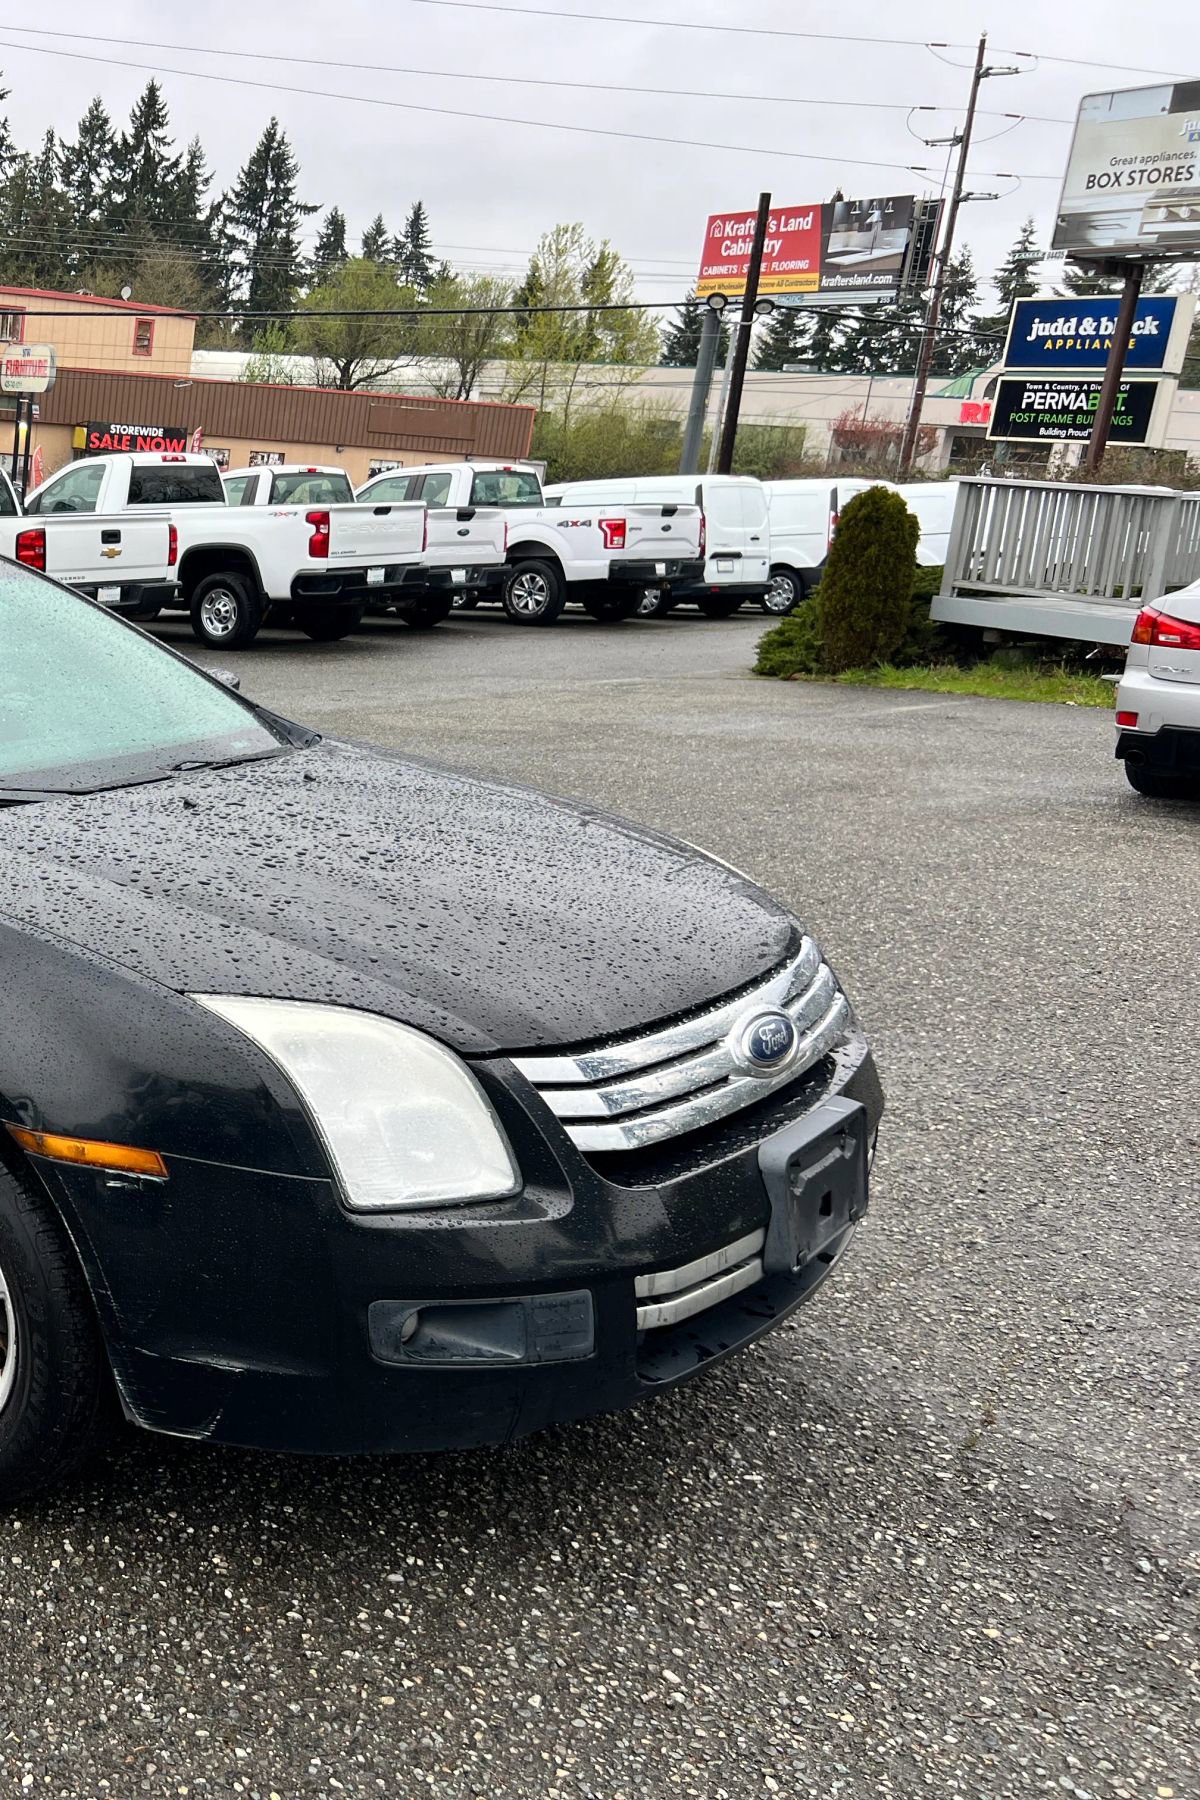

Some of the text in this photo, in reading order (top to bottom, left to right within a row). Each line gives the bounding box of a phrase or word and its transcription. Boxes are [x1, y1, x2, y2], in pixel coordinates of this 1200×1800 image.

[1109, 150, 1197, 167] Great appliances.
[1085, 164, 1195, 190] BOX STORES
[724, 211, 814, 237] Kraft's Land
[702, 264, 738, 276] CABINETS
[770, 260, 810, 272] FLOORING
[821, 273, 893, 287] kraftersland.com
[1026, 315, 1160, 341] judd & blck
[1044, 338, 1137, 350] APPLIANE
[6, 359, 49, 378] FURNITURE
[1052, 383, 1080, 392] Country,
[1010, 412, 1036, 423] POST
[1038, 413, 1073, 424] FRAME
[110, 424, 164, 437] STOREWIDE
[1039, 427, 1066, 438] Building
[89, 432, 185, 453] SALE NOW
[758, 1022, 788, 1055] Ford
